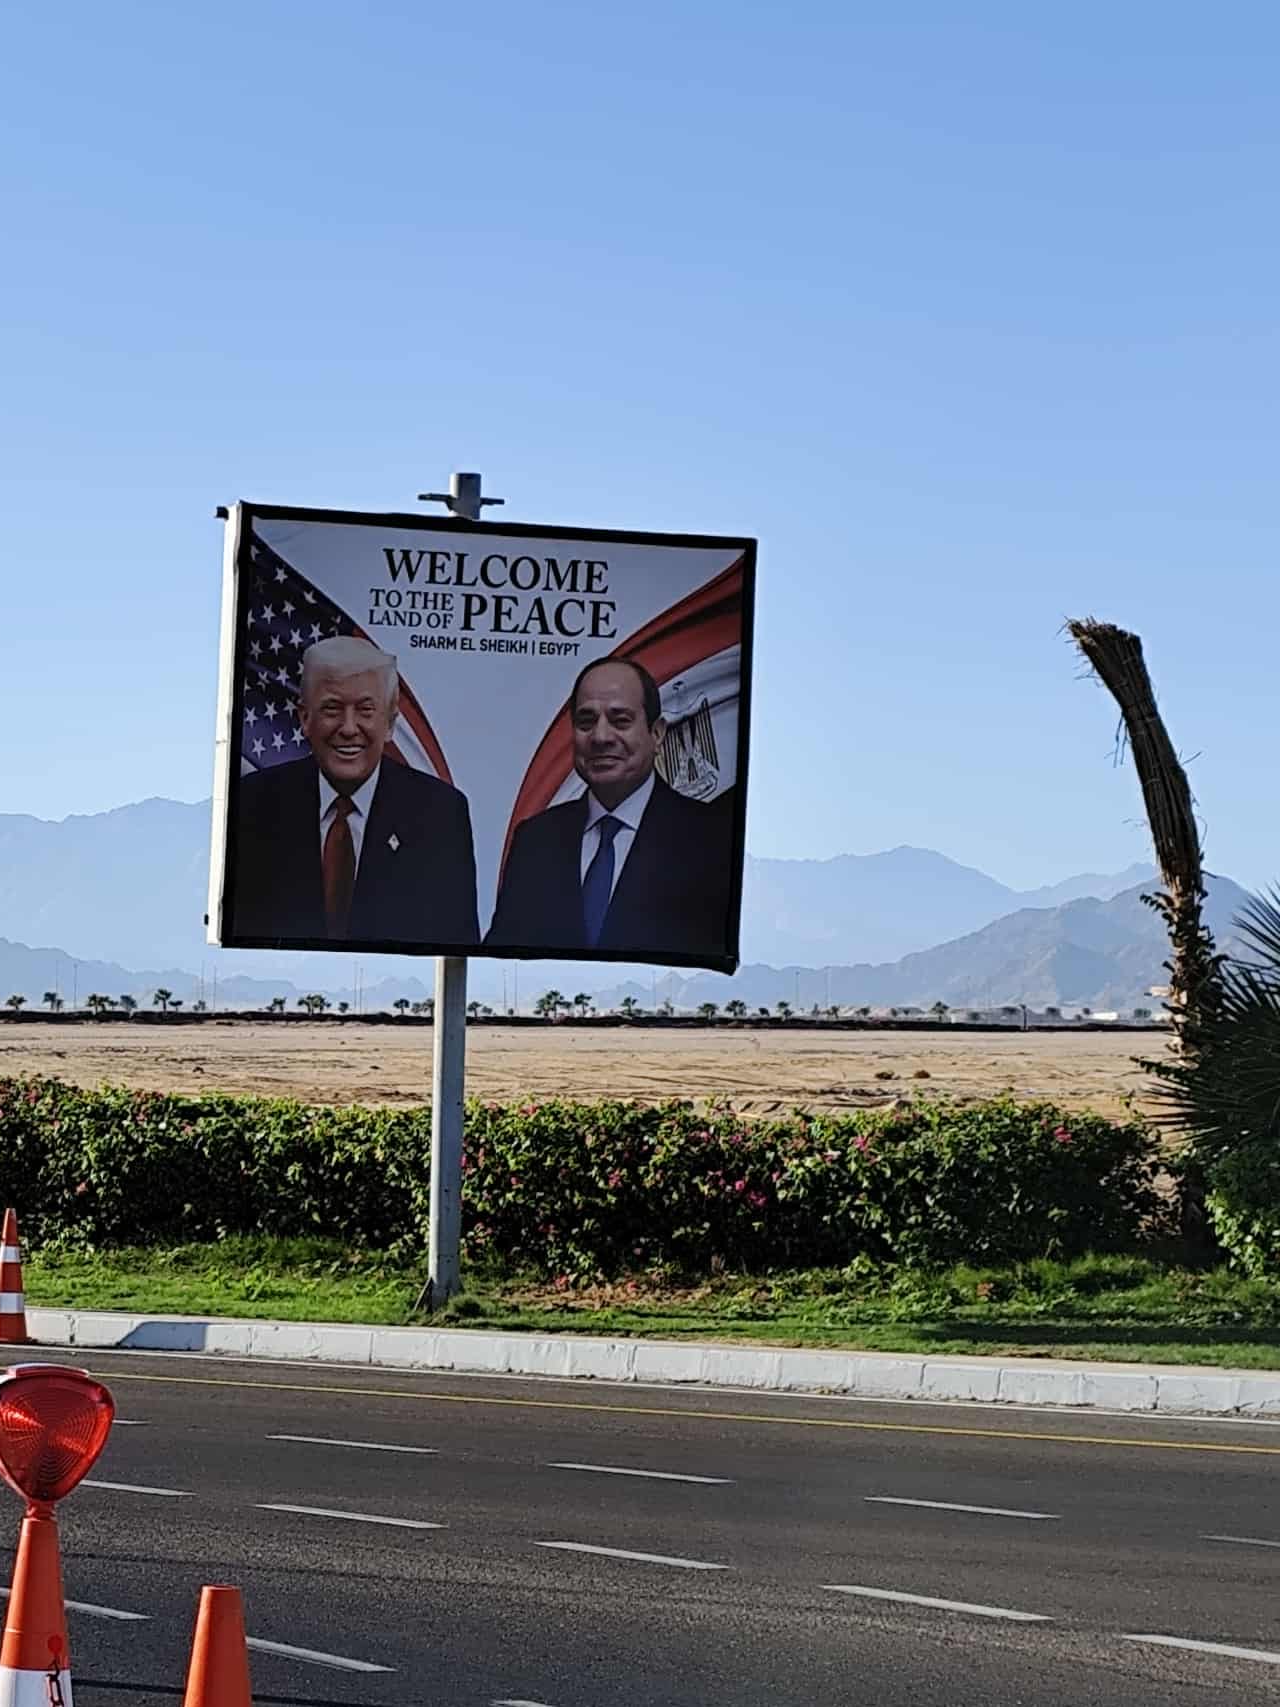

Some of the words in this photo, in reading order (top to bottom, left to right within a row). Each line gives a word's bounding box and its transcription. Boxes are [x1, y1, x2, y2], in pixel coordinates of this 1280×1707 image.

[382, 547, 609, 595] WELCOME
[369, 587, 404, 609] TO
[406, 590, 454, 612] THE
[368, 608, 421, 628] LAND
[426, 612, 454, 630] OF
[460, 592, 618, 639] PEACE
[409, 634, 457, 651] SHARM
[460, 637, 477, 652] EL
[479, 638, 528, 655] SHEIKH
[538, 641, 581, 657] EGYPT
